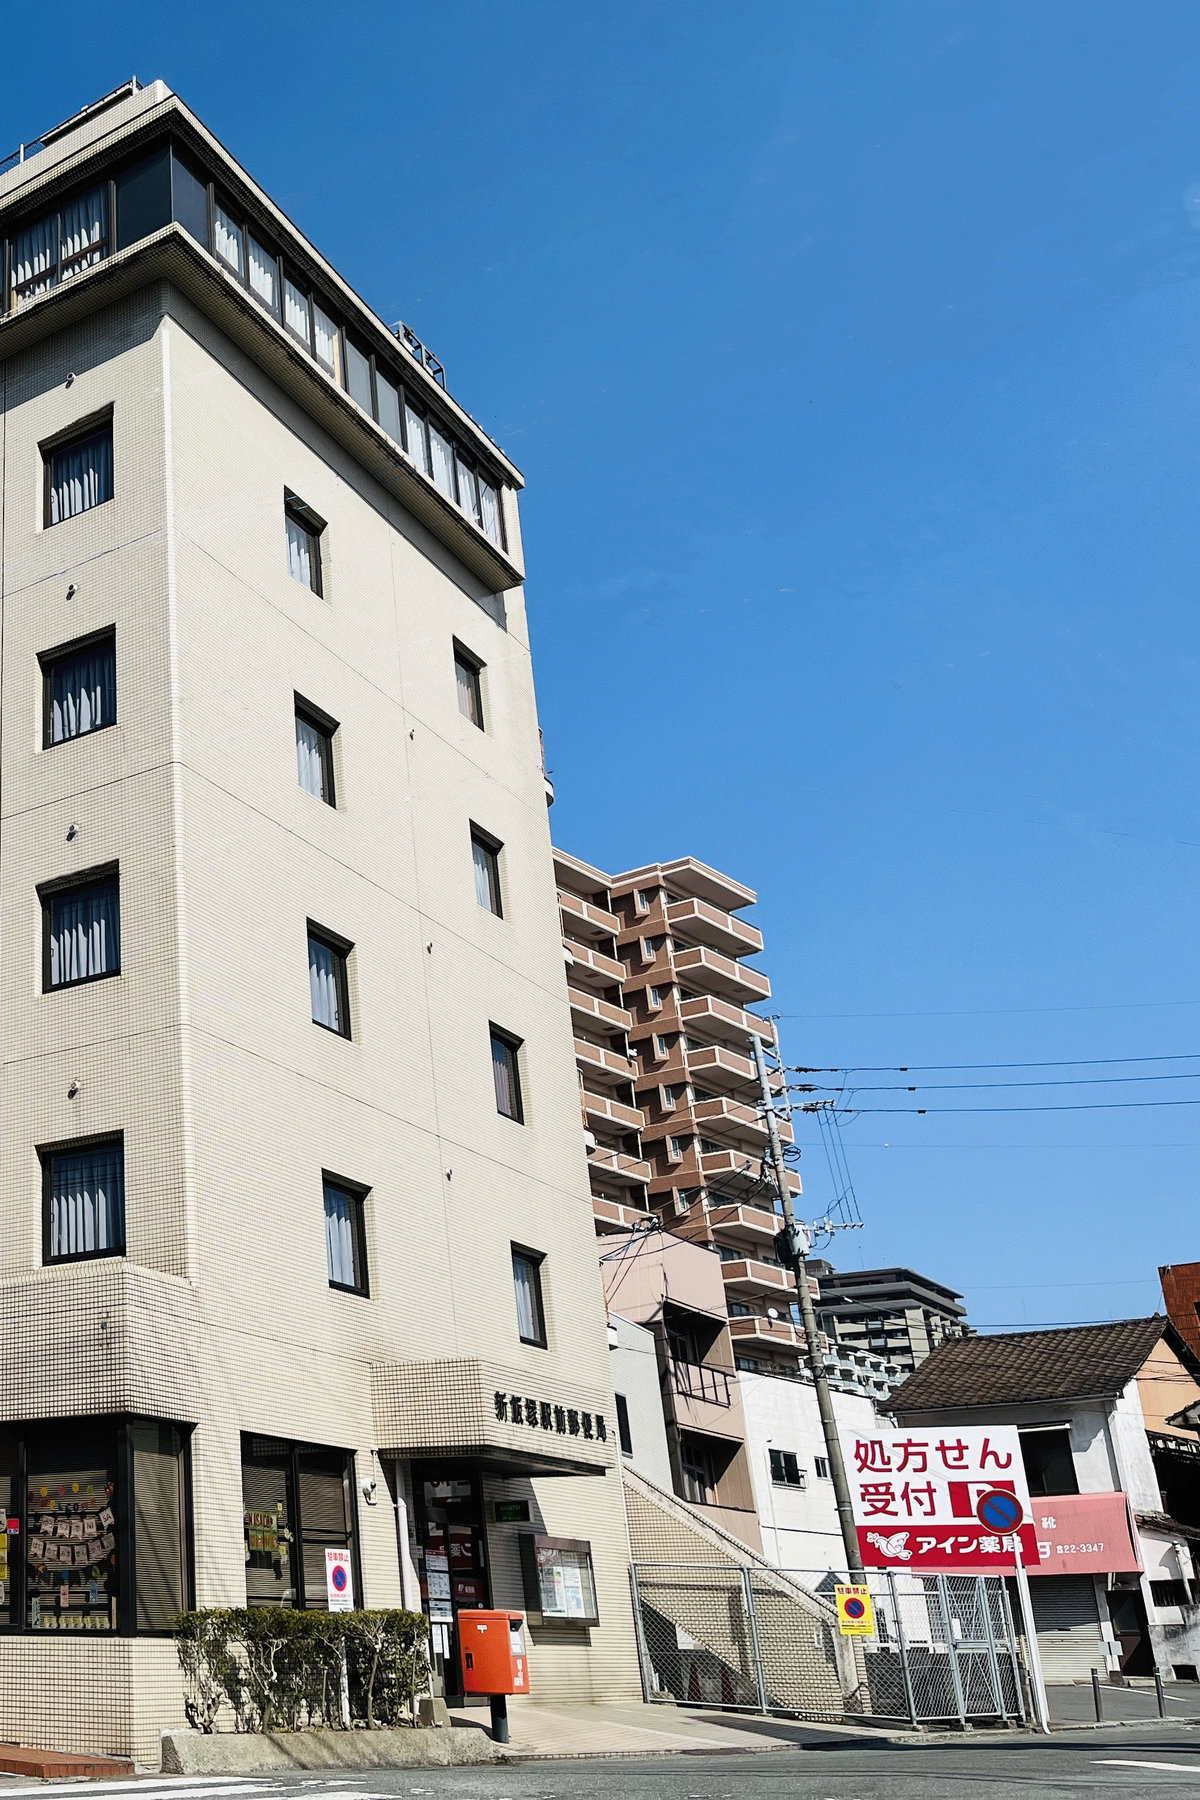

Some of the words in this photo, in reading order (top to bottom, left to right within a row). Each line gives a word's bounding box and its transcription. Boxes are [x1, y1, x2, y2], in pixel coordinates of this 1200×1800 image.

[854, 1438, 1012, 1473] 処方せん
[859, 1481, 937, 1517] 受付
[1041, 1516, 1057, 1529] 靴
[915, 1535, 1024, 1554] アイン薬局
[837, 1587, 867, 1595] 駐車禁止
